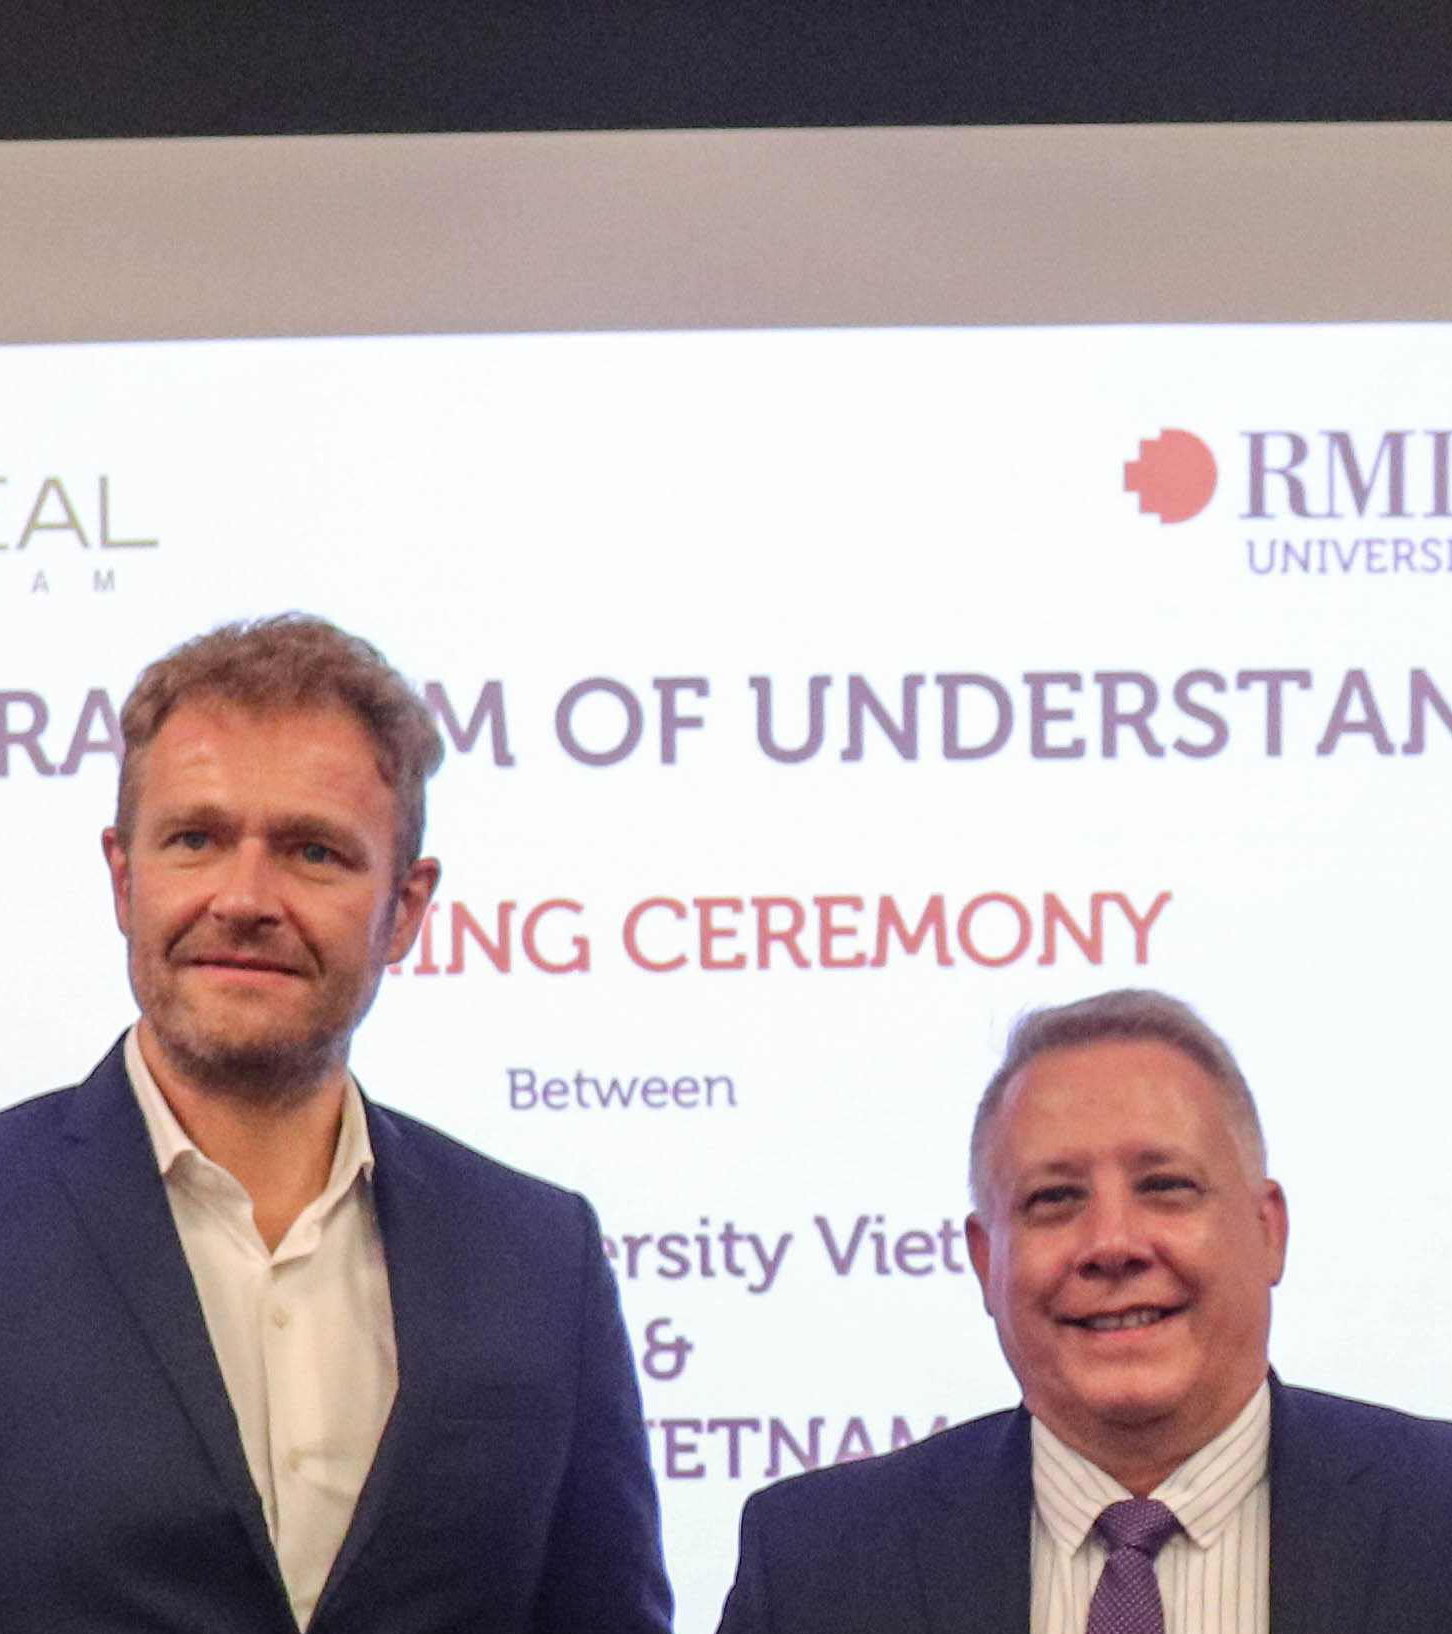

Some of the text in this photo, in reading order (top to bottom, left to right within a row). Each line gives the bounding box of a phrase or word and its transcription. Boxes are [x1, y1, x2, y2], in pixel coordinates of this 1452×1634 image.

[555, 676, 710, 768] OF
[622, 891, 1172, 973] CEREMONY
[506, 1067, 737, 1111] Between
[813, 1214, 963, 1277] Viet
[641, 1319, 694, 1380] &
